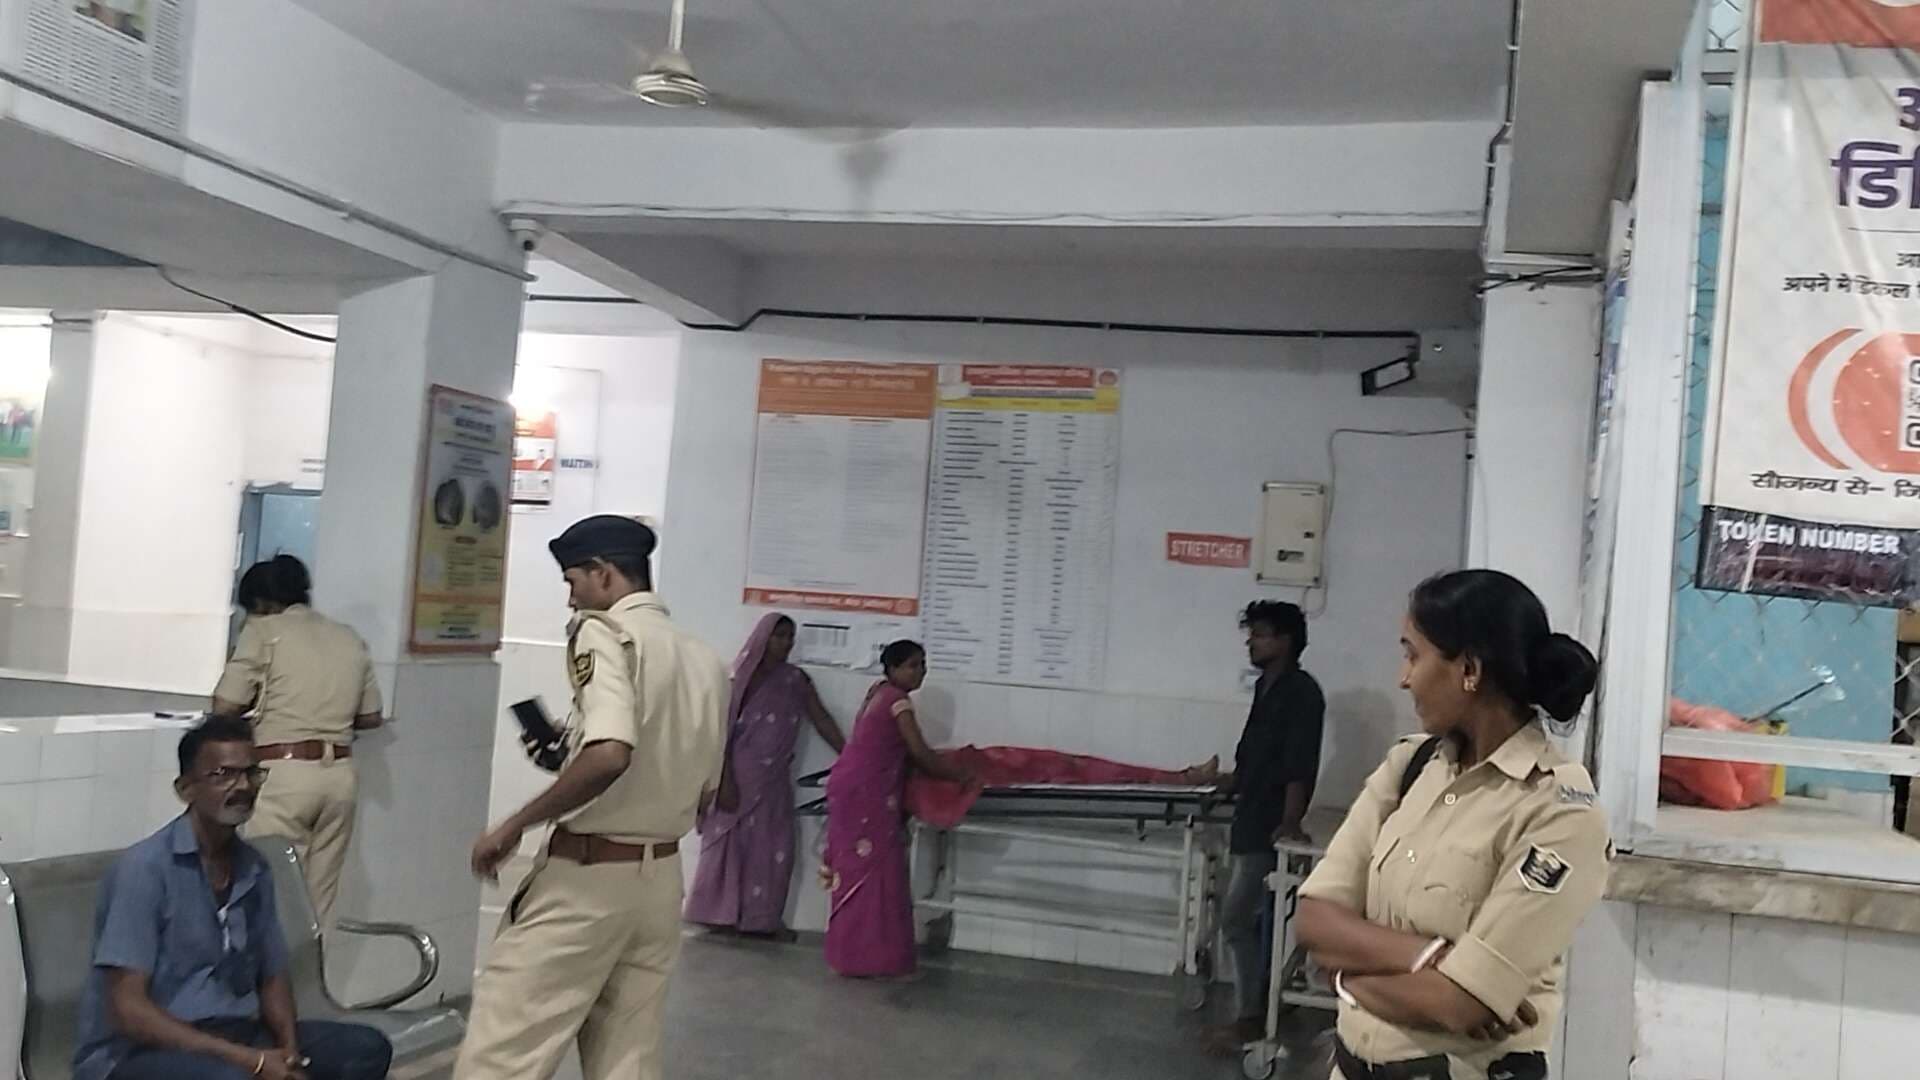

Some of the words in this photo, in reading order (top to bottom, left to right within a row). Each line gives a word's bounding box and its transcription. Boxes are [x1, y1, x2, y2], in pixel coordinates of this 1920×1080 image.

[1783, 272, 1831, 292] अपने
[1718, 520, 1796, 546] TOKEN
[1800, 526, 1900, 554] NUMBER
[1171, 540, 1245, 560] STRETCHER
